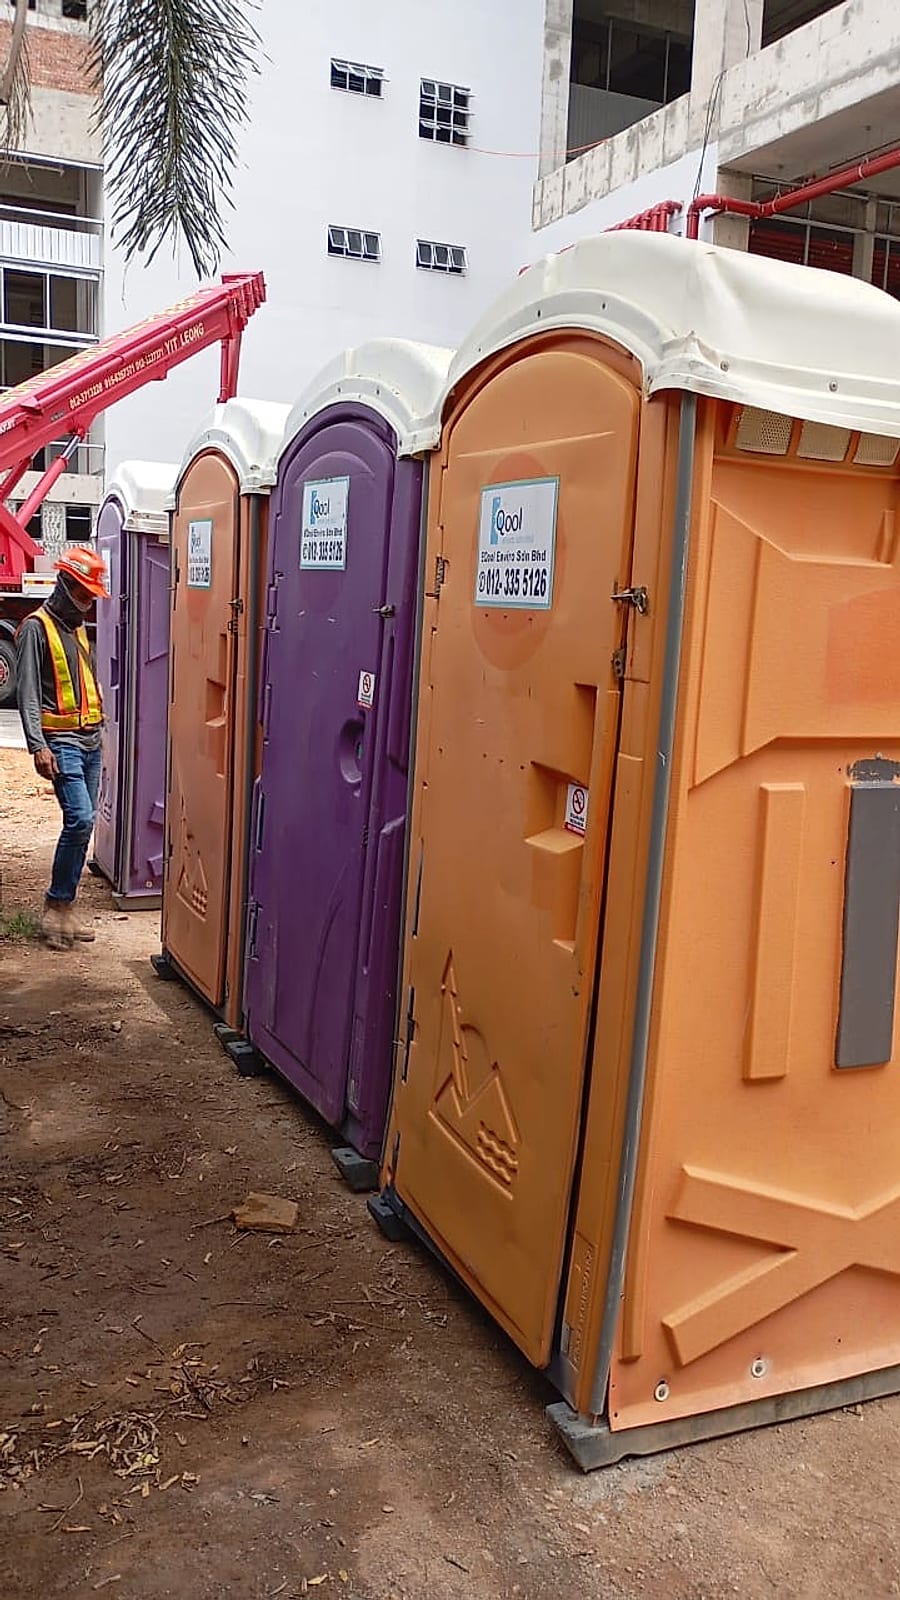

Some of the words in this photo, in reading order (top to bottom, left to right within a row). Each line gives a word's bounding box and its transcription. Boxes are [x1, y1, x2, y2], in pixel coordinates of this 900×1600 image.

[164, 336, 178, 356] YIT
[180, 322, 204, 346] LEONG
[496, 507, 523, 536] Qool
[504, 568, 521, 596] 335
[522, 568, 547, 597] 5126
